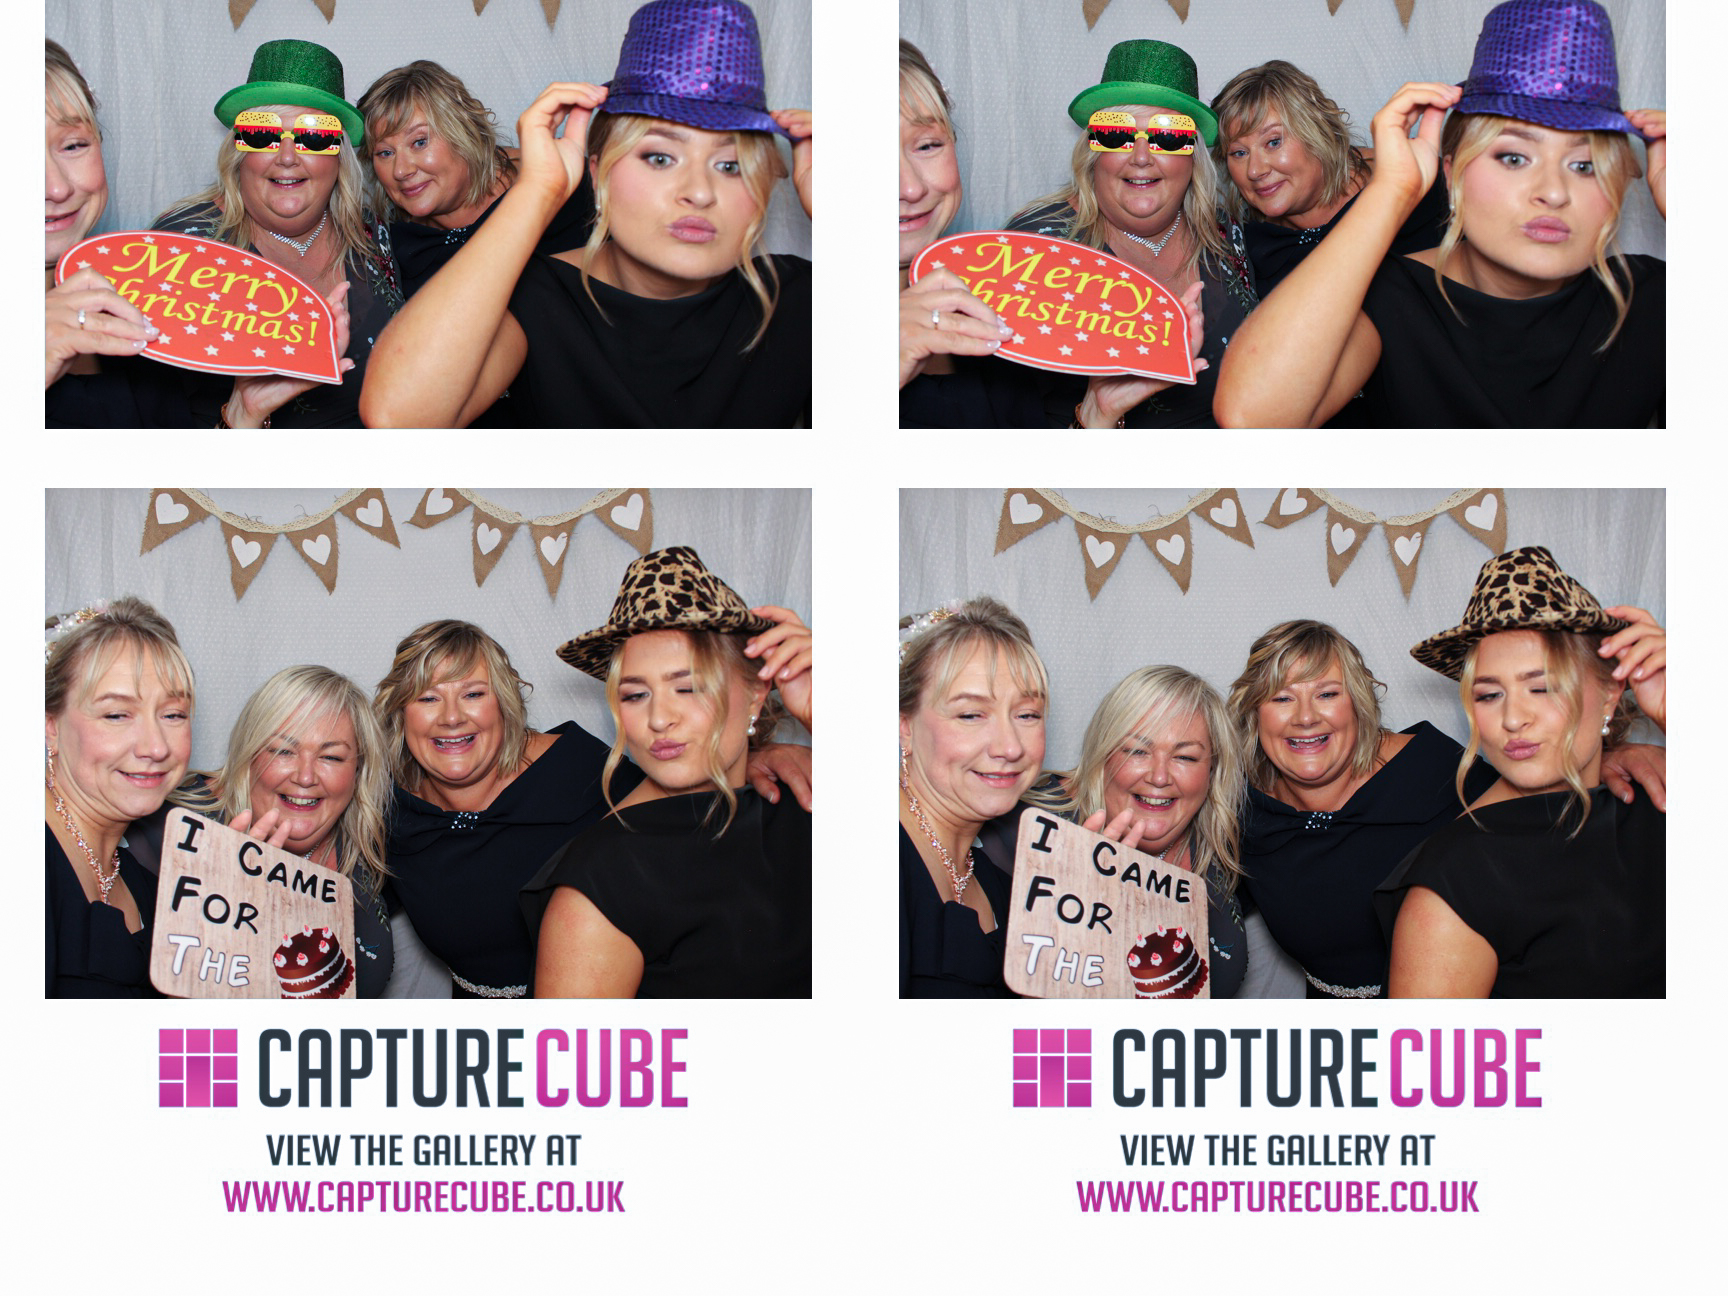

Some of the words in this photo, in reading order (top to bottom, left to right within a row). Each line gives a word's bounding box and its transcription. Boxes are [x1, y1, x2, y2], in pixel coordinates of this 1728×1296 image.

[104, 274, 319, 347] hristmas!
[112, 242, 299, 318] Merry
[958, 274, 1173, 347] hristmas!
[966, 242, 1153, 318] Merry
[176, 815, 206, 854] I
[238, 841, 337, 903] CAME
[1030, 815, 1060, 854] I
[1092, 841, 1191, 903] CAME
[171, 875, 259, 935] FOR
[1025, 875, 1113, 935] FOR
[167, 933, 251, 988] THE
[1021, 933, 1105, 988] THE
